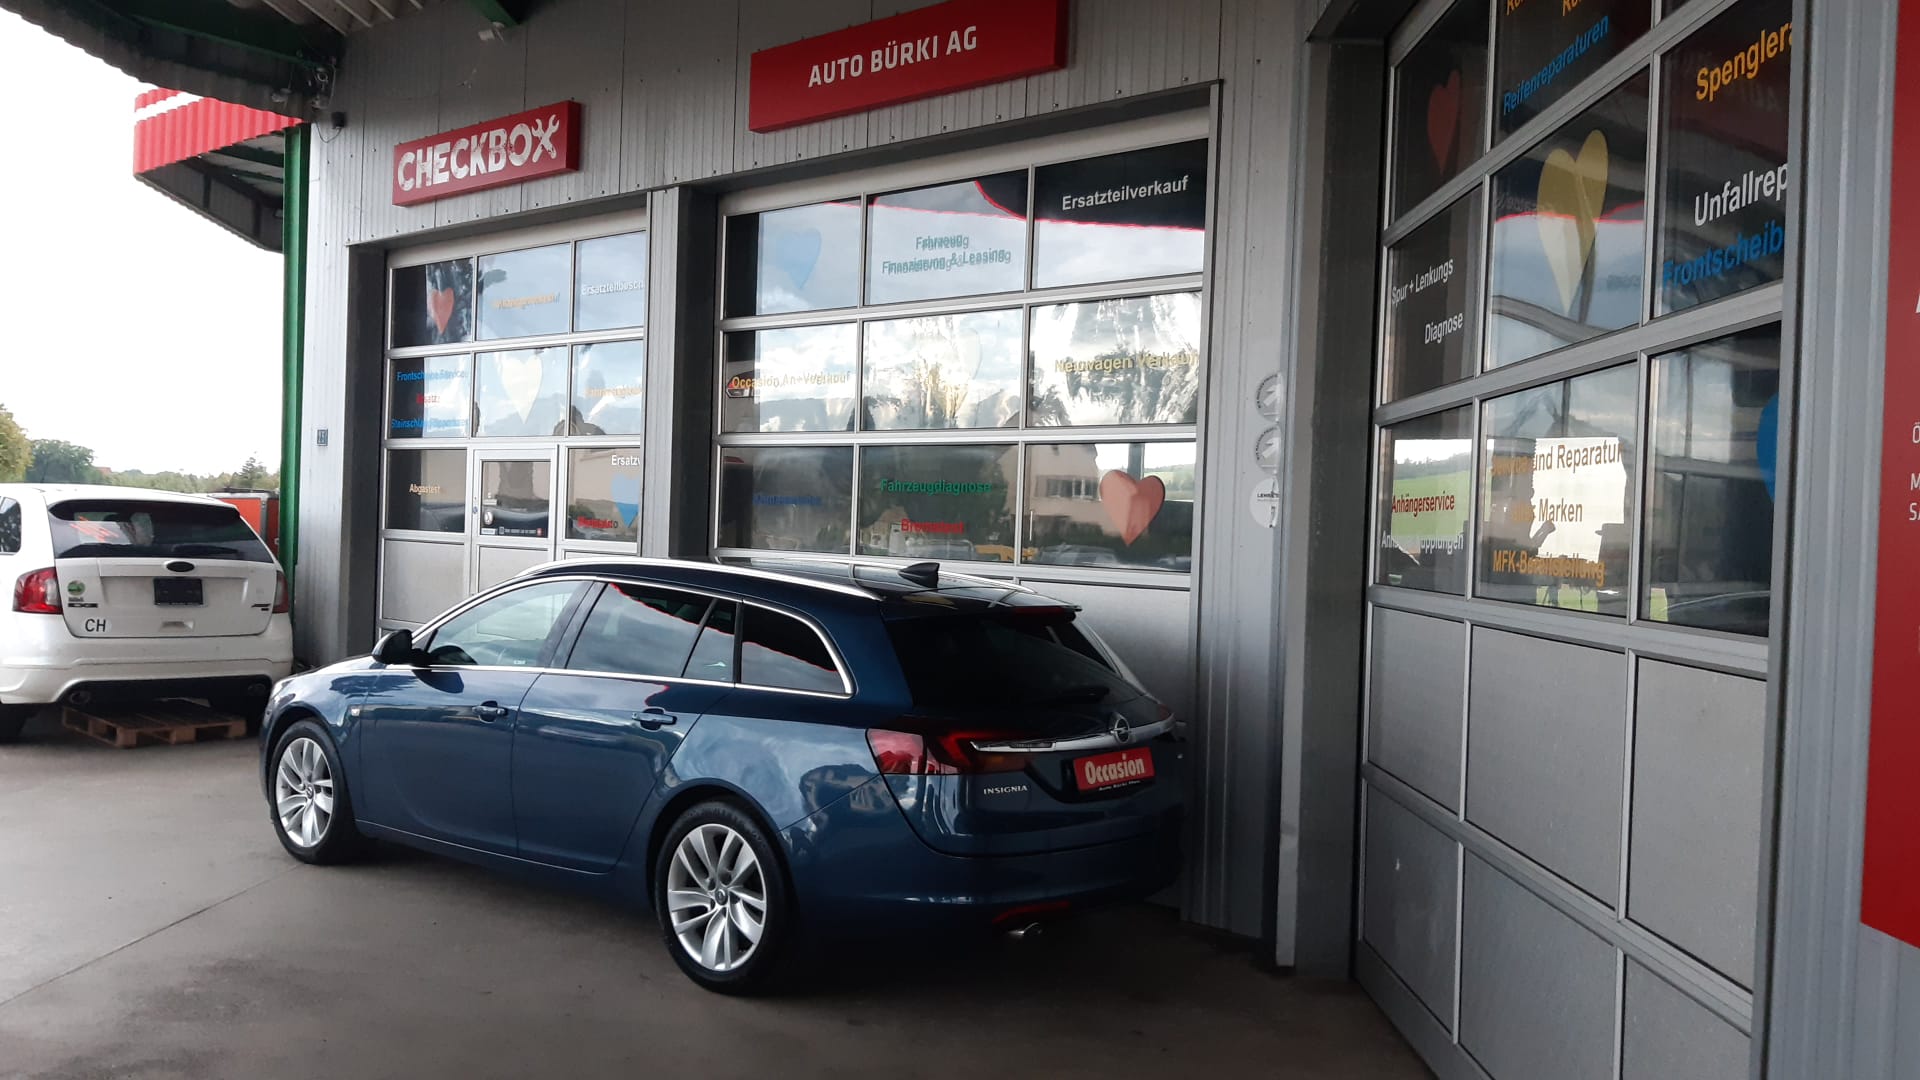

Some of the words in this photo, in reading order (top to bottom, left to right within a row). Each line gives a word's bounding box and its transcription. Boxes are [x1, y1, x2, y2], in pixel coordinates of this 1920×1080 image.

[808, 54, 863, 88] AUTO
[870, 35, 938, 73] BÜRKI
[946, 25, 977, 56] AG
[1503, 15, 1609, 116] Reifenreparaturen
[397, 114, 560, 191] CHECKBOX
[1062, 174, 1189, 211] Ersatzteilverkauf
[1415, 258, 1454, 293] Lenkungs
[1424, 312, 1464, 344] Diagnose
[880, 478, 993, 497] Fahrzeugdiagnose
[1392, 490, 1456, 518] Anhängerservice
[1538, 498, 1584, 523] Marken
[85, 618, 107, 633] CH
[1084, 753, 1145, 785] Occasion
[983, 784, 1028, 795] INSIGNIA
